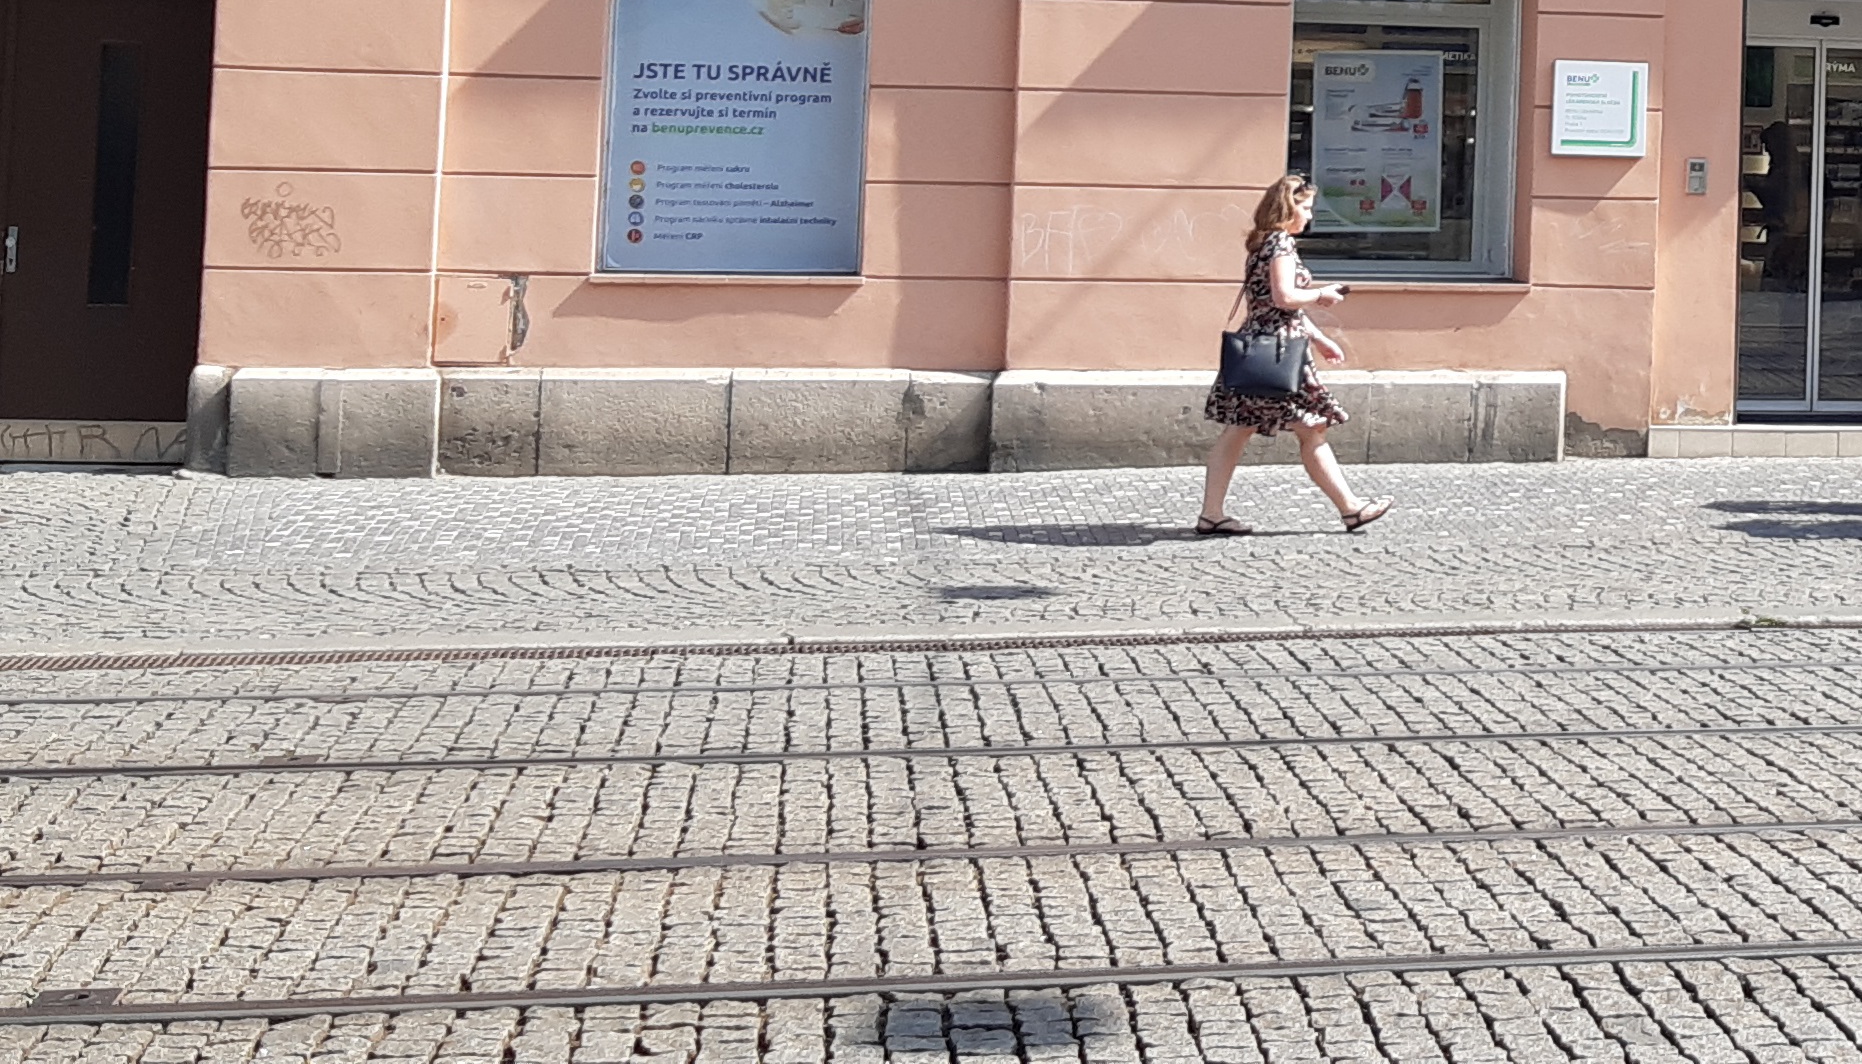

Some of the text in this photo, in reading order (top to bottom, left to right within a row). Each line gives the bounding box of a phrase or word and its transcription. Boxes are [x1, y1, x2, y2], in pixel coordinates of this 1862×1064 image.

[633, 61, 833, 84] JSTE TU SPRÁVNĚ
[1566, 75, 1591, 83] BENU
[633, 88, 832, 106] Zvolte si preventivní program
[632, 106, 777, 121] a rezervujte si termín
[631, 122, 764, 136] na benuprevence.cz
[685, 232, 703, 240] CRP
